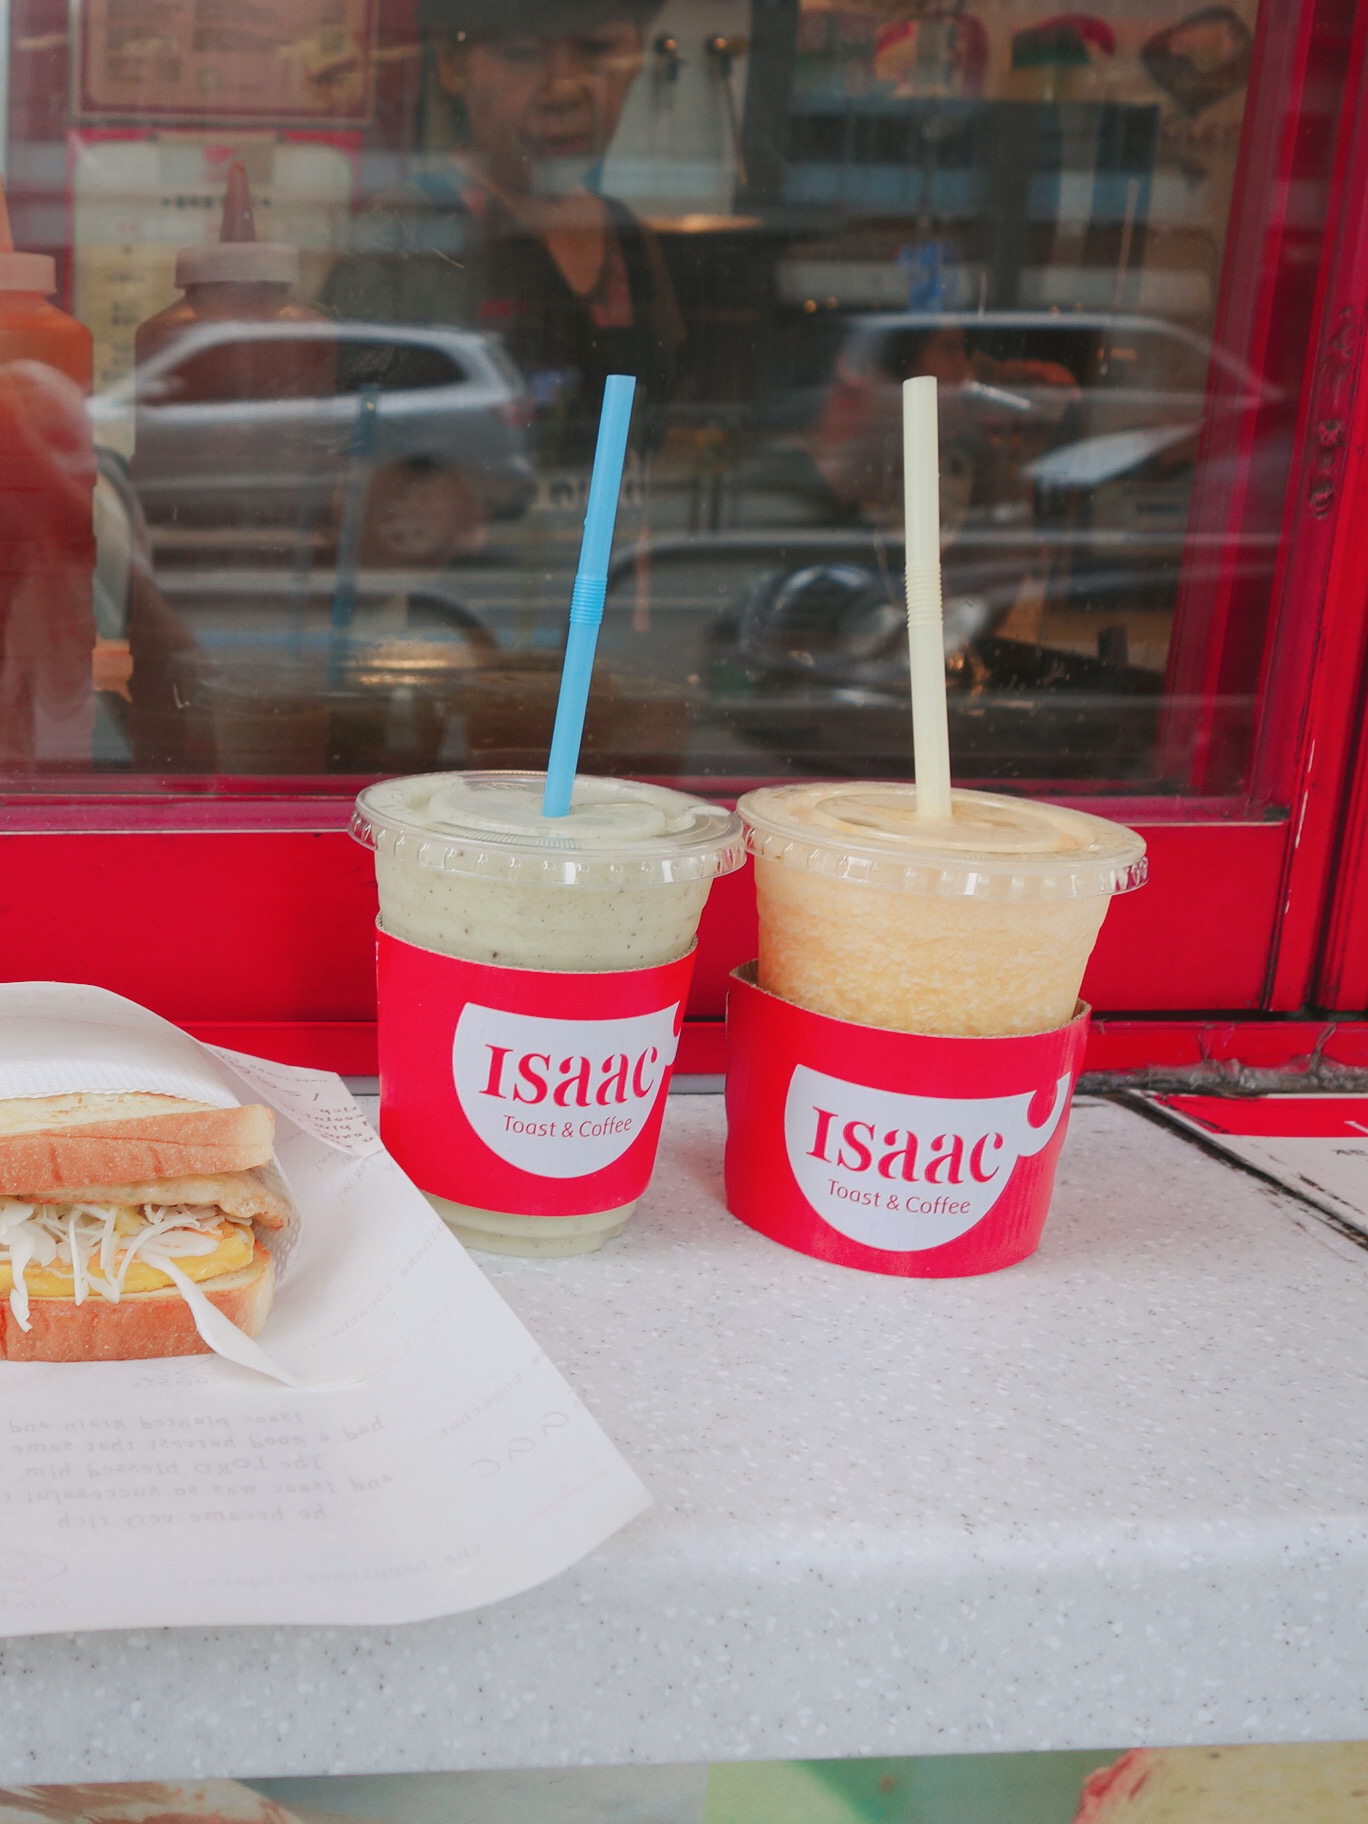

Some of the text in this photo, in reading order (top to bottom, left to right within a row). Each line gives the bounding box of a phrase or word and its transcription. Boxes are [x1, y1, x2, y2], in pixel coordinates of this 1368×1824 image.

[479, 1043, 658, 1107] Isaac
[503, 1114, 633, 1138] Toast & Coffee
[806, 1106, 1004, 1185] Isaac
[828, 1178, 971, 1215] Toast & Coffee
